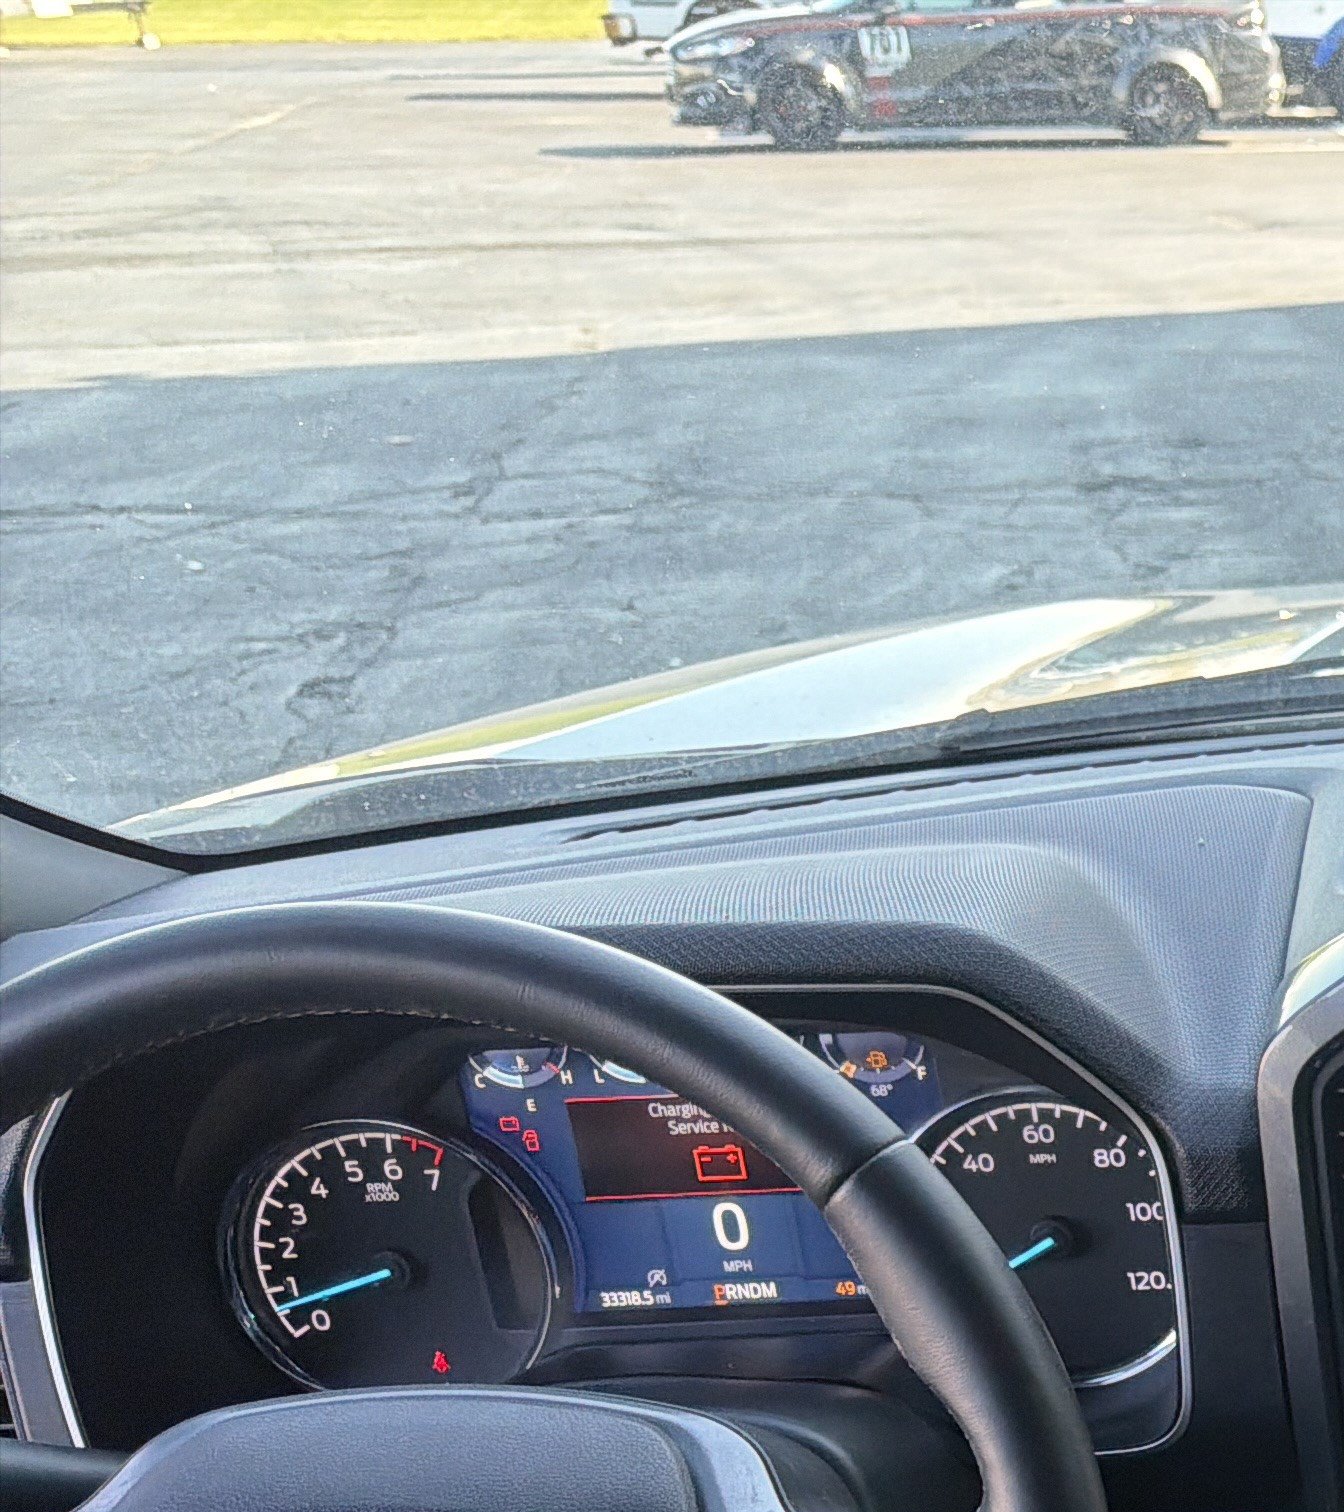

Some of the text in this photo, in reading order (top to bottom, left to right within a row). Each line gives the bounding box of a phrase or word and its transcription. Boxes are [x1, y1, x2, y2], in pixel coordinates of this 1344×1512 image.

[560, 1070, 573, 1085] H
[593, 1069, 605, 1084] L
[526, 1098, 537, 1112] E
[667, 1120, 719, 1136] Service
[1022, 1124, 1055, 1144] 60
[962, 1153, 995, 1173] 40
[1030, 1153, 1057, 1165] MPH
[1093, 1148, 1126, 1168] 80
[343, 1159, 364, 1182] 5
[383, 1158, 404, 1181] 6
[310, 1177, 329, 1199] 4
[366, 1182, 393, 1193] RPM
[423, 1169, 441, 1191] 7
[288, 1203, 308, 1225] 3
[712, 1202, 749, 1250] 0
[278, 1236, 298, 1259] 2
[723, 1260, 753, 1272] MPH
[286, 1276, 299, 1297] 1
[836, 1281, 856, 1296] 49
[310, 1309, 331, 1331] 0
